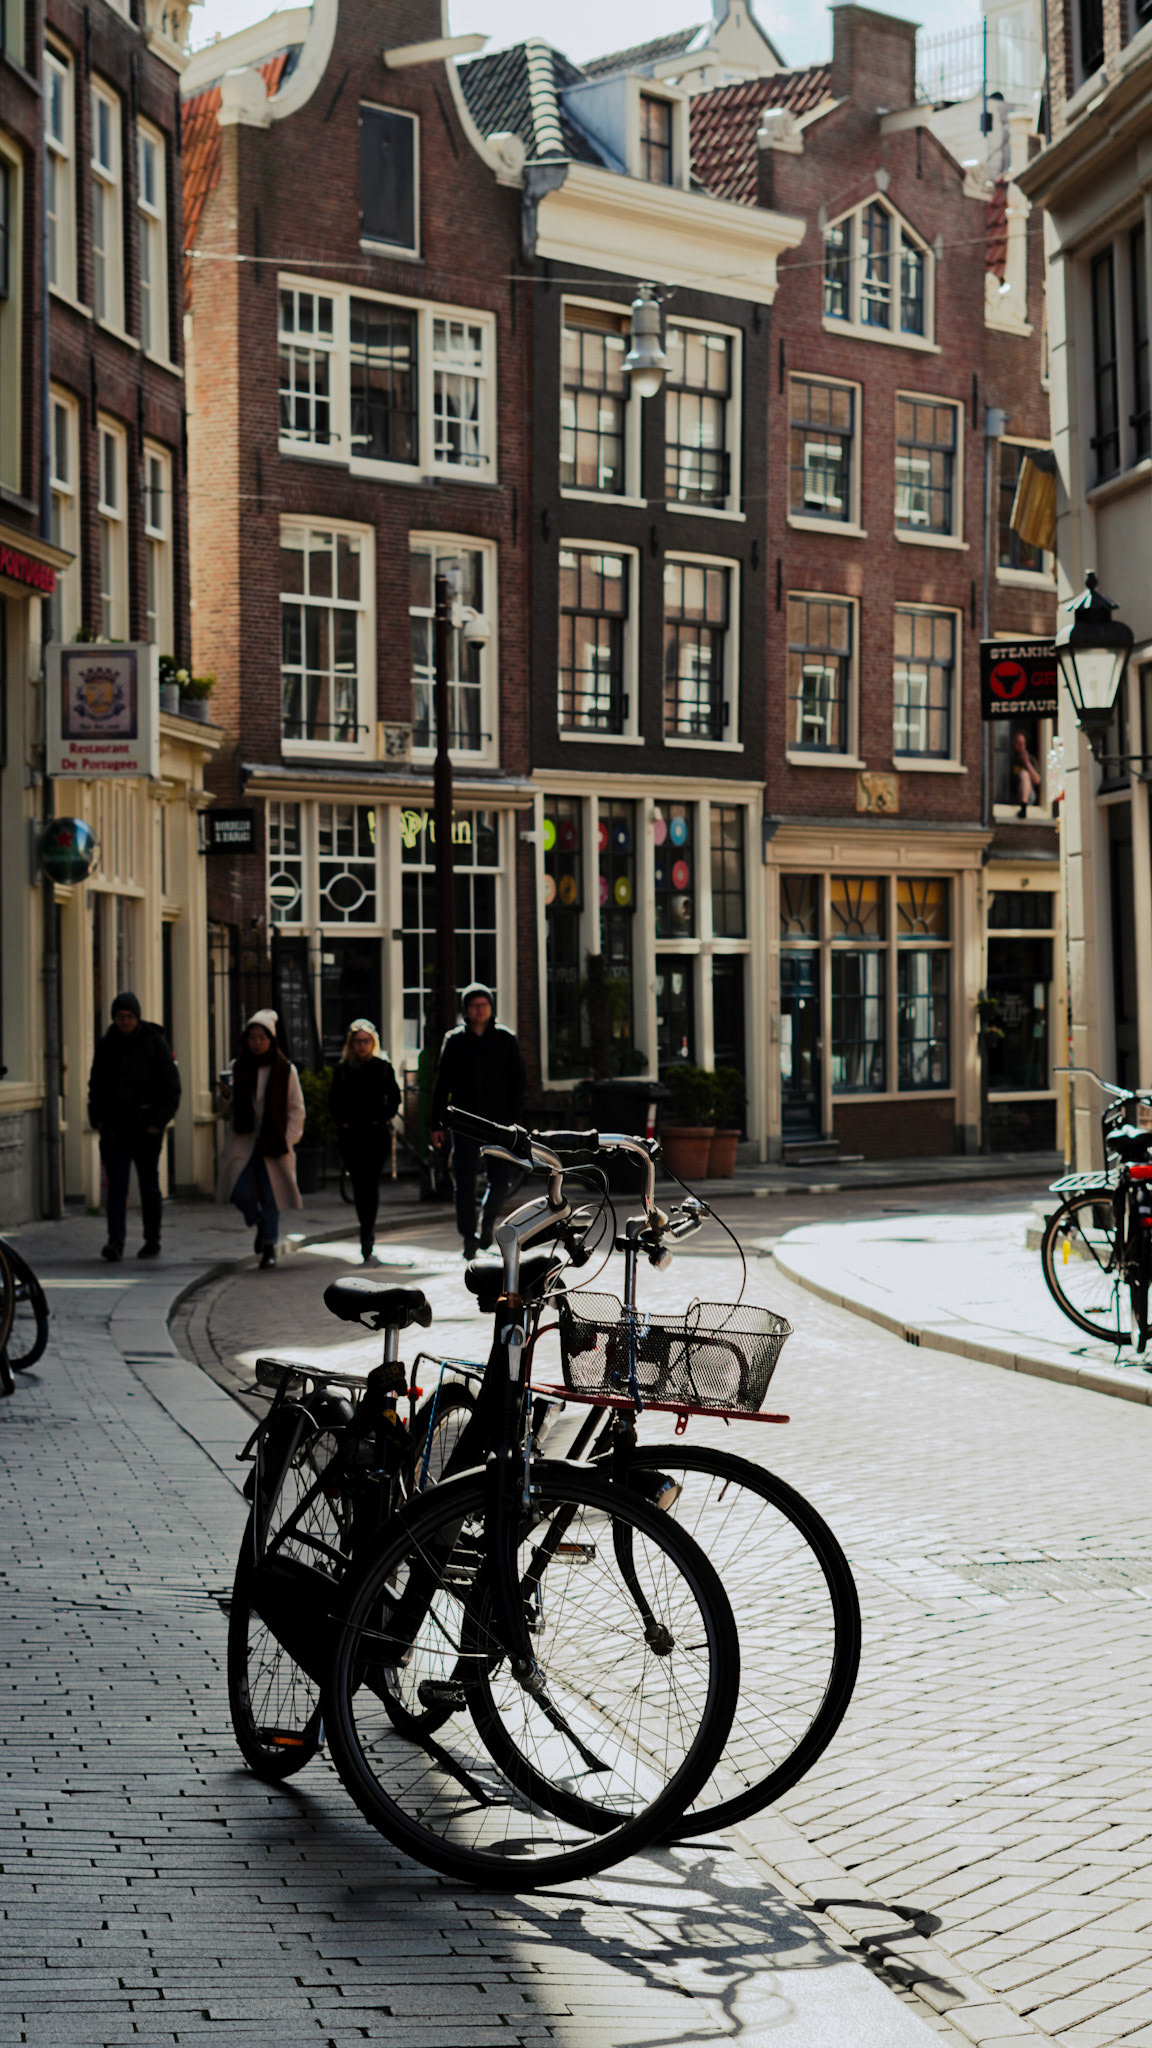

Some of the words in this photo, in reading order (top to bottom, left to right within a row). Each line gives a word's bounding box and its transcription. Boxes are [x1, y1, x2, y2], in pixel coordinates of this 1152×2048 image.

[990, 645, 1057, 659] STEAKHO
[1031, 671, 1057, 687] GR
[990, 699, 1058, 713] RESTAUR
[69, 741, 130, 754] Restaurant
[61, 757, 77, 770] De
[82, 757, 138, 772] Portugees
